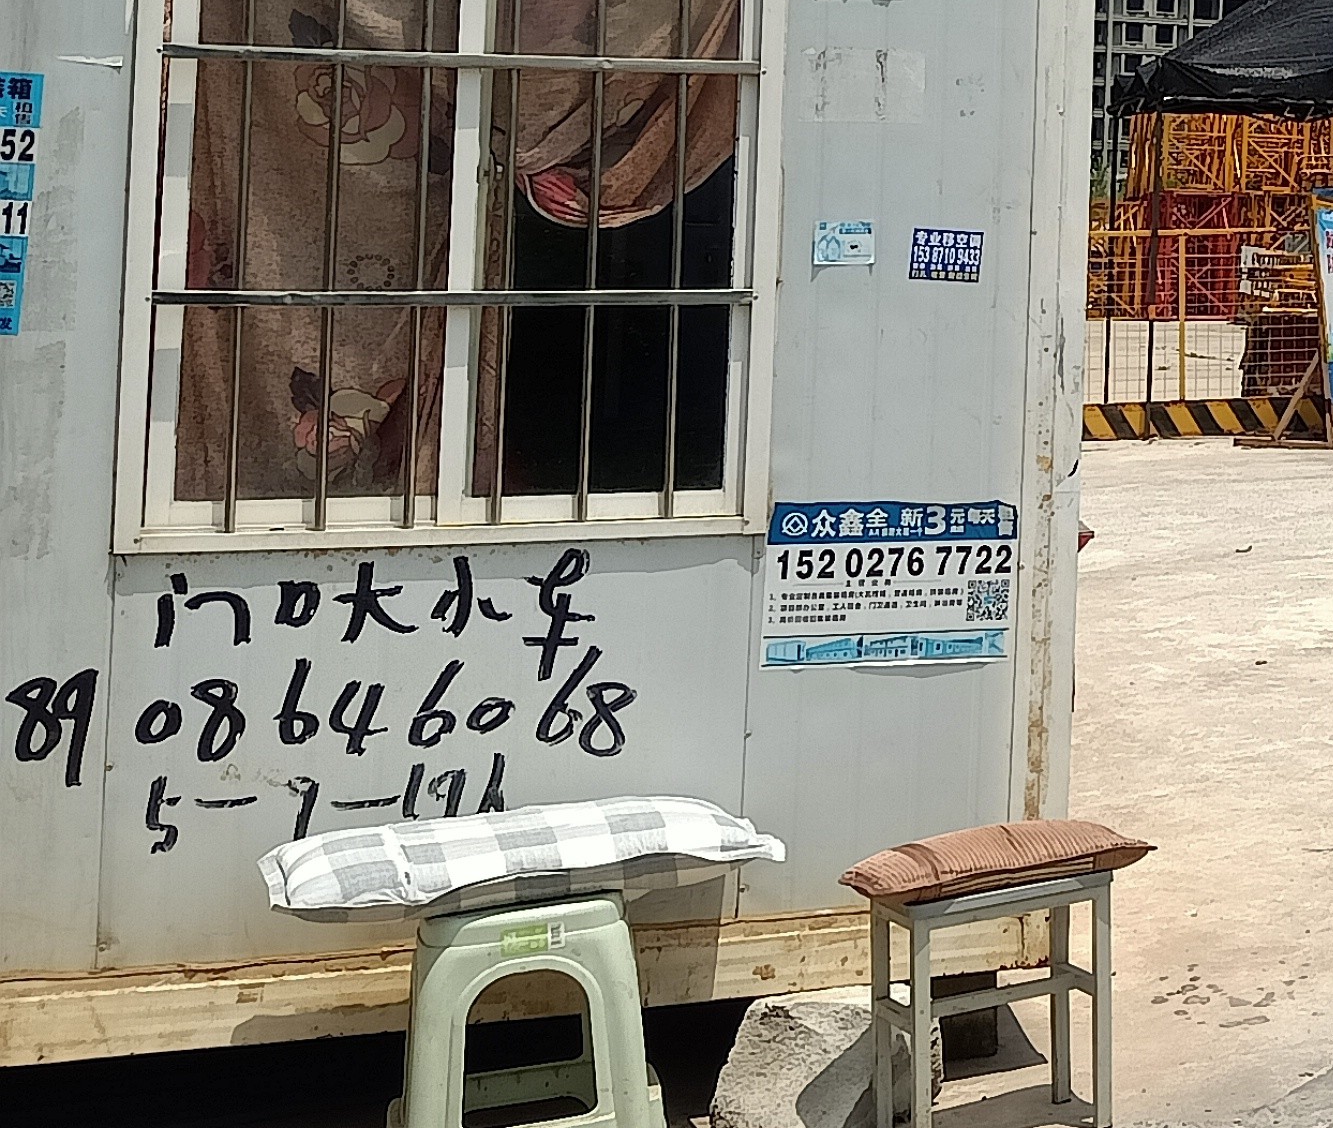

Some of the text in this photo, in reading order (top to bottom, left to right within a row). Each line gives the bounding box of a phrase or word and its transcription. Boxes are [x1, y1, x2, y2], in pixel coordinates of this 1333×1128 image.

[0, 128, 35, 163] 52
[913, 245, 930, 263] 153
[956, 248, 981, 266] 9433
[811, 507, 889, 538] 众鑫全
[776, 544, 1013, 580] 152 0276 7722
